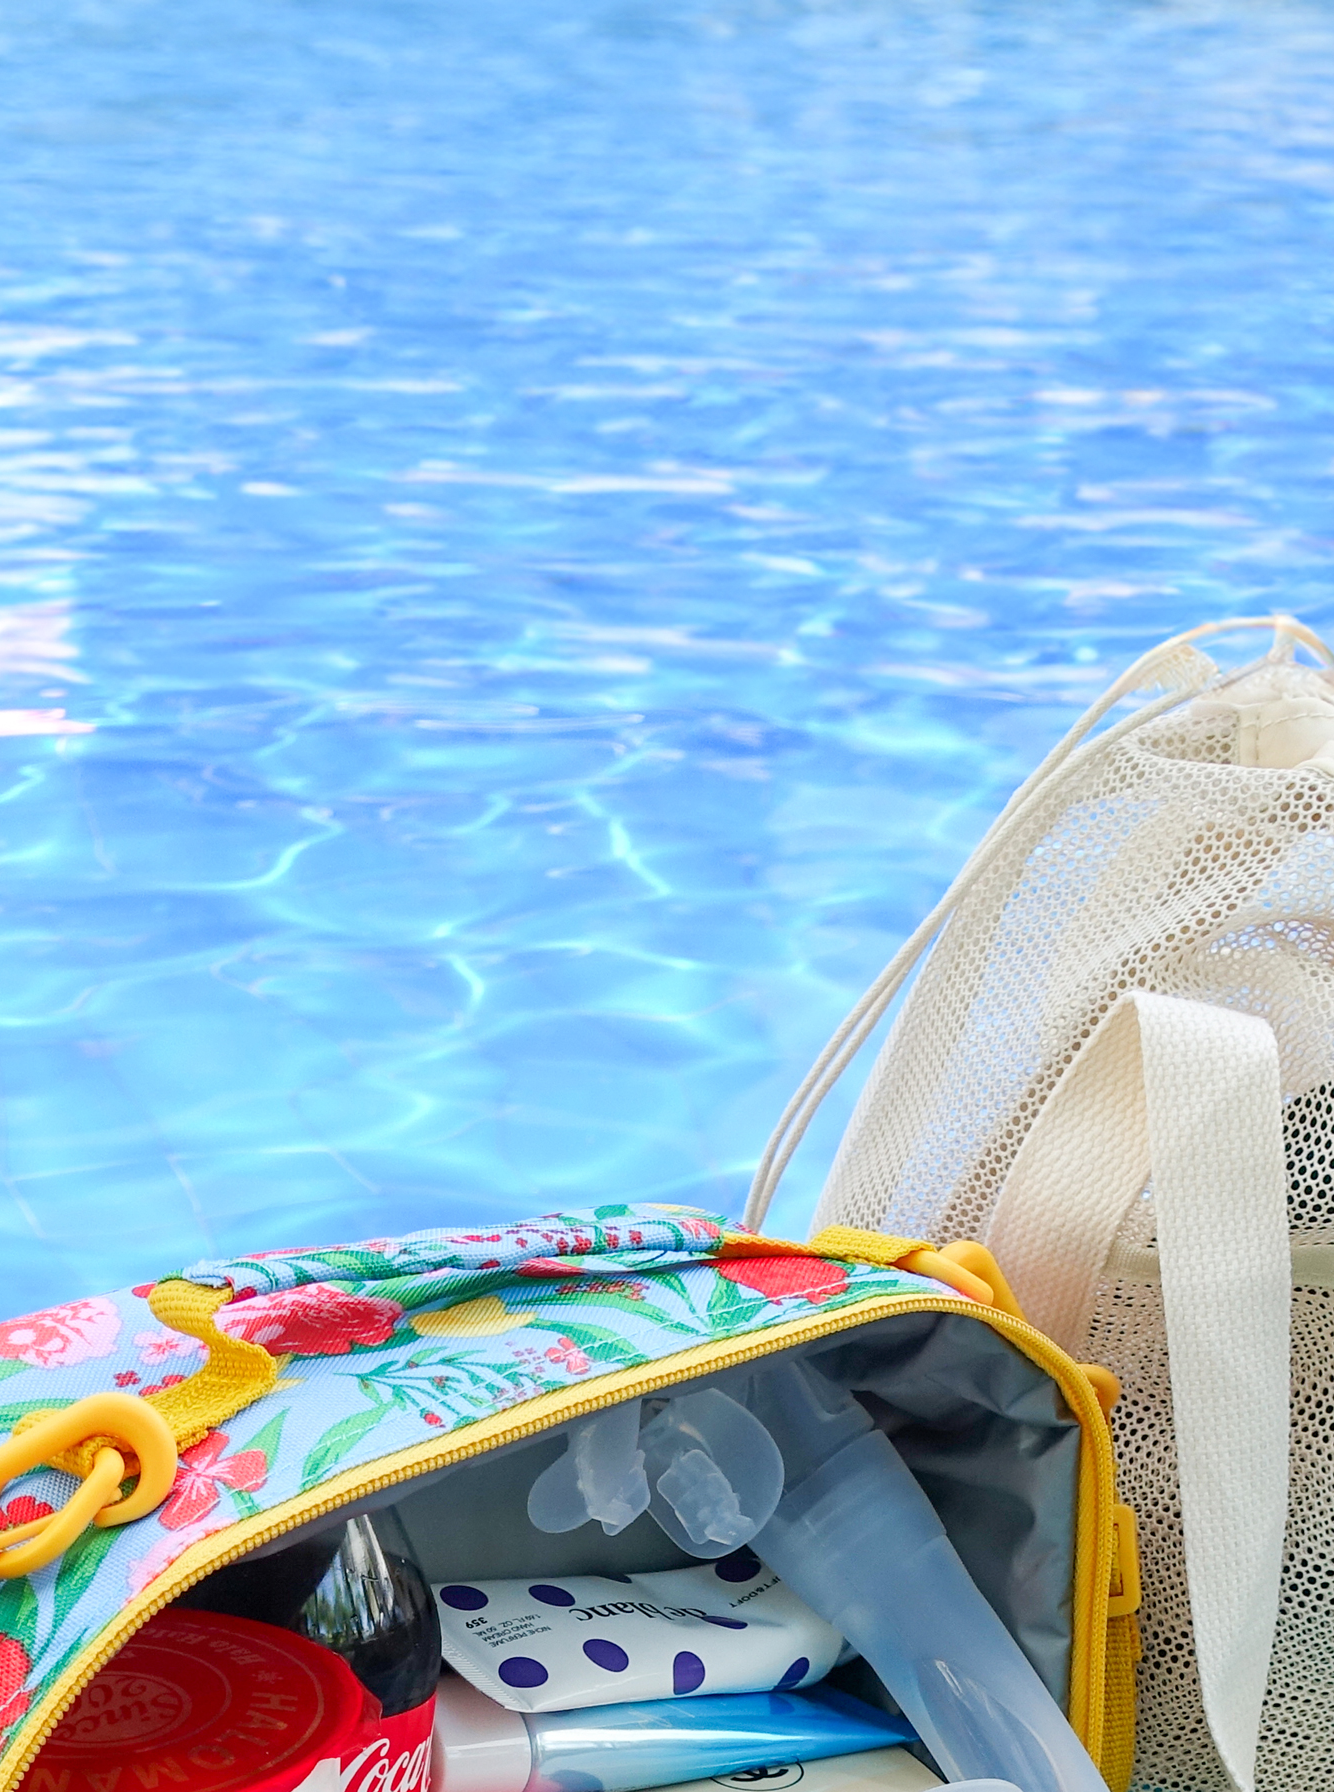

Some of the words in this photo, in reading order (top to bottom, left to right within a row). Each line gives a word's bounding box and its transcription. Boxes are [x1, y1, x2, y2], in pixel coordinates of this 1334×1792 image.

[465, 1616, 488, 1629] 359
[511, 1622, 535, 1633] HAND
[481, 1629, 512, 1642] CREAM
[526, 1625, 552, 1636] NICHE
[488, 1631, 528, 1649] PERFUME
[53, 1692, 182, 1739] Since
